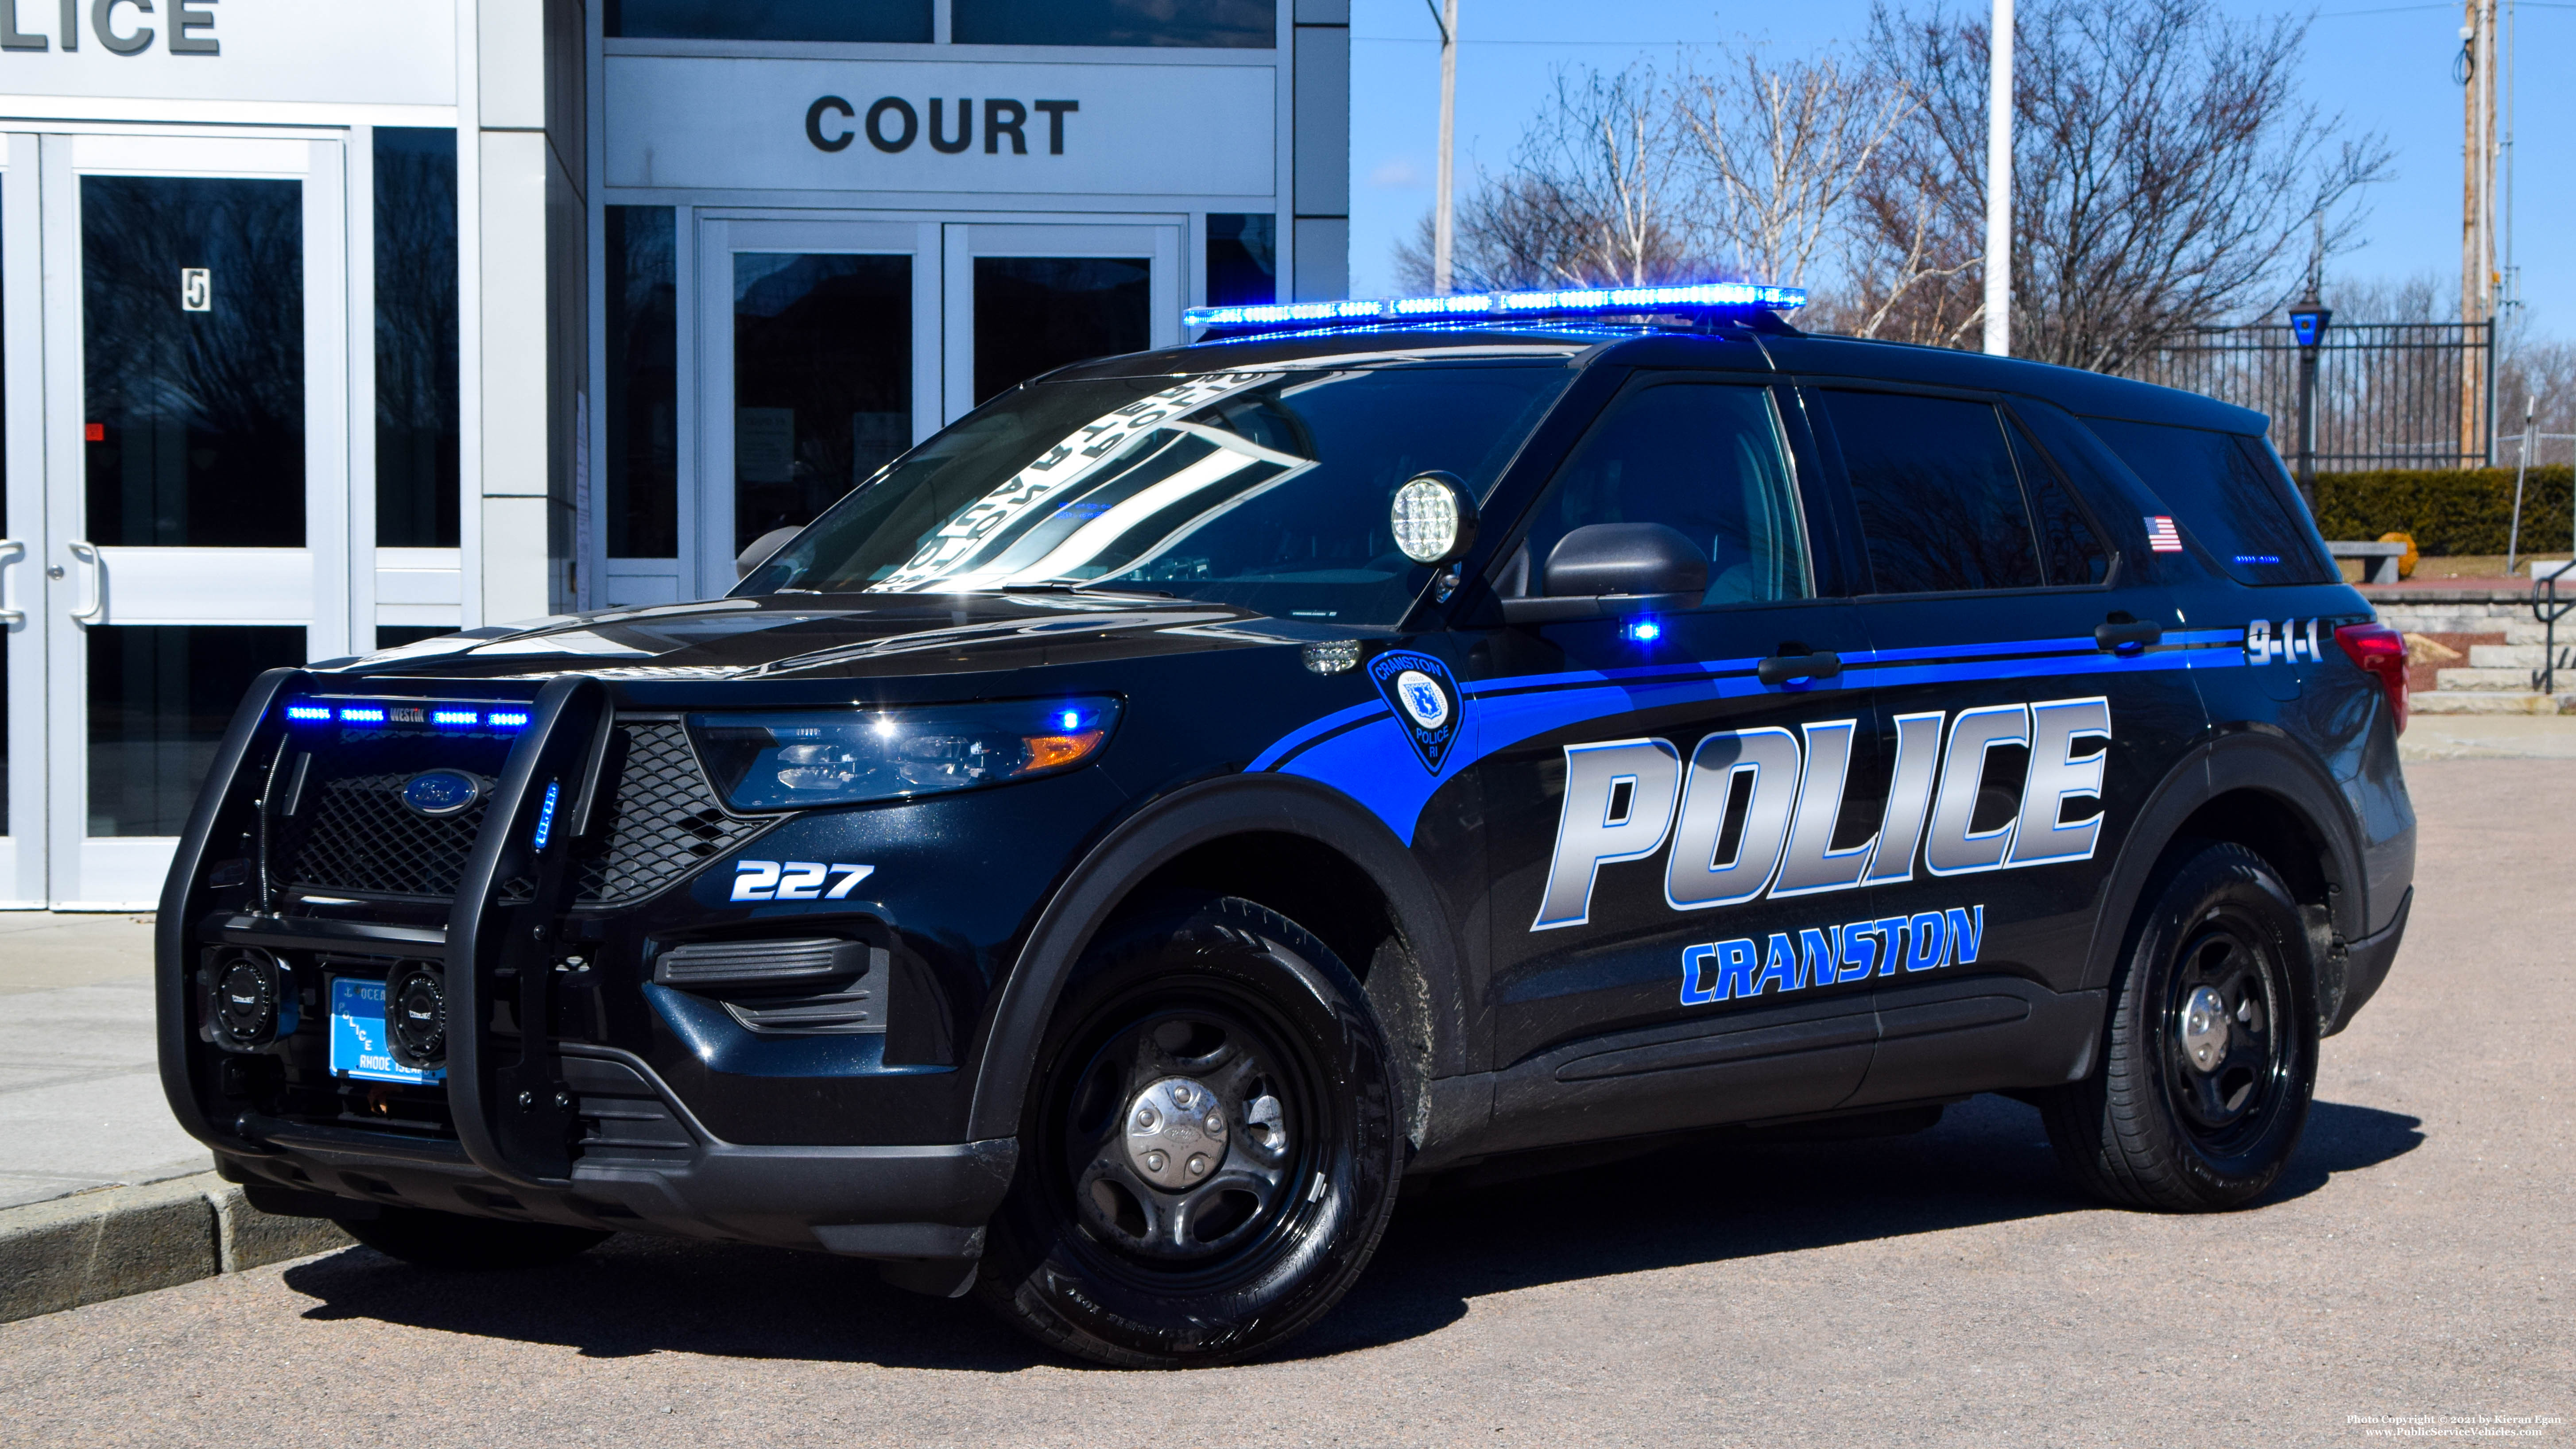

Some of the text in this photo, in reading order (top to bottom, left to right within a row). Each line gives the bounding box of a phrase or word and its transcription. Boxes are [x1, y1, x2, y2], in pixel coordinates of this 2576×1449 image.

[805, 96, 1078, 156] COURT
[186, 269, 206, 309] 5
[2247, 618, 2323, 666] 9-1-1
[1375, 656, 1442, 680] CRANSTON
[1435, 689, 1447, 709] CURO
[1416, 725, 1449, 744] POLICE
[1429, 747, 1438, 758] RI
[1530, 696, 2112, 932] POLICE
[729, 859, 875, 901] 227
[1680, 904, 1983, 1006] CRANSTON
[360, 988, 386, 1001] OCEA
[338, 1002, 373, 1051] POLICE
[360, 1055, 391, 1072] RHODE
